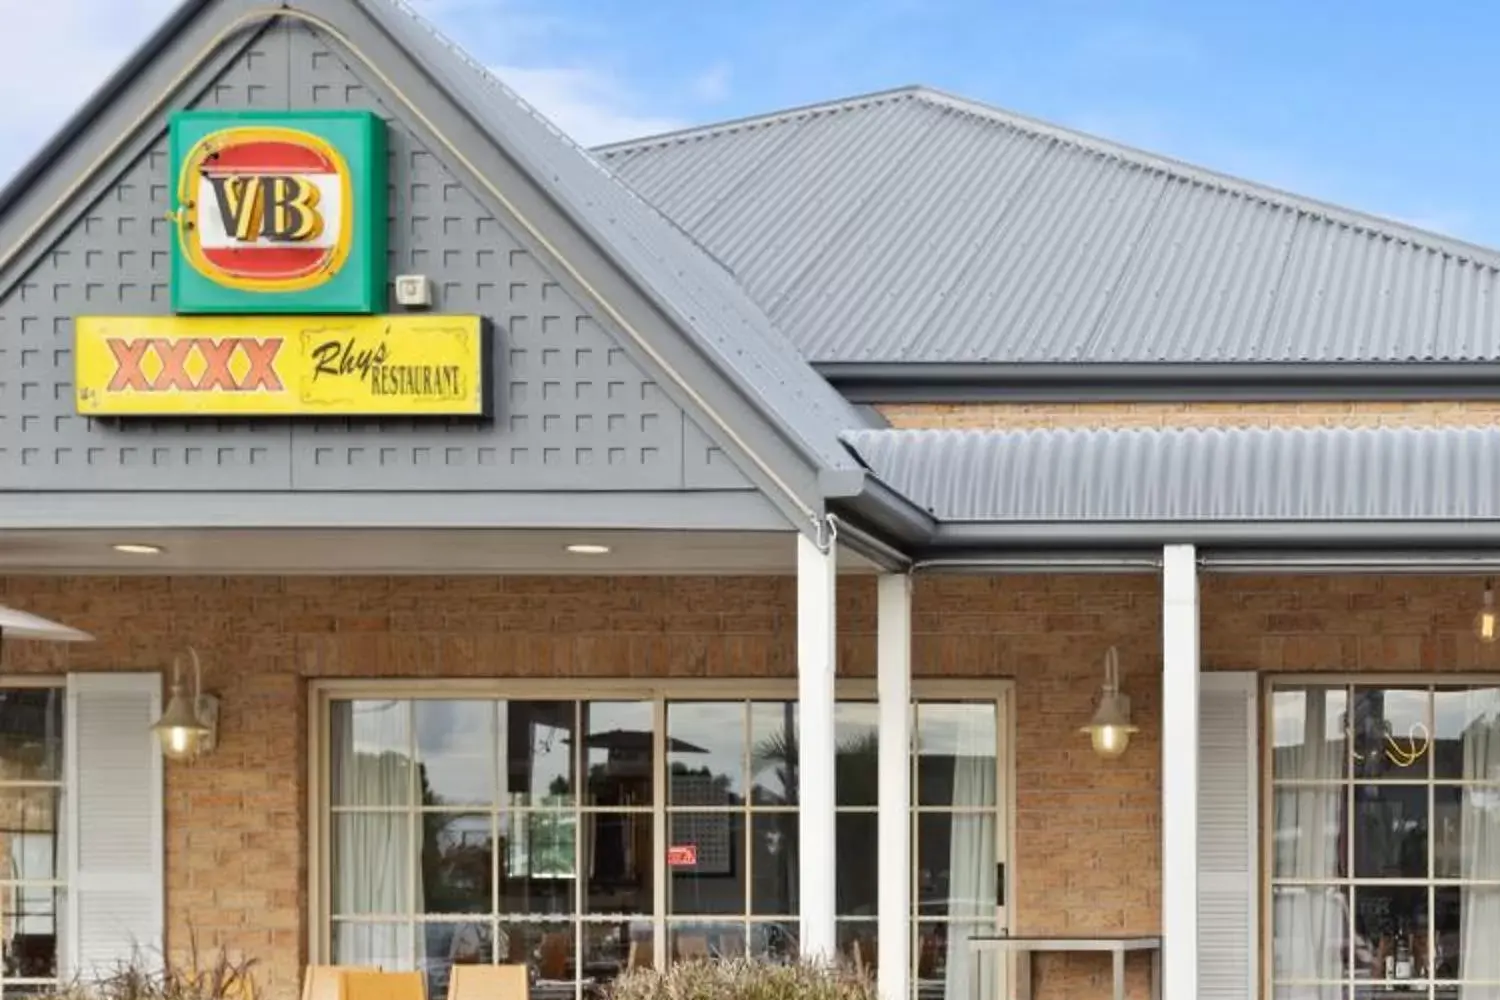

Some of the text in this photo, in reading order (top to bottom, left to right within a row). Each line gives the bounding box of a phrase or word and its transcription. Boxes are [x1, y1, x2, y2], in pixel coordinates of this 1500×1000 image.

[206, 175, 325, 241] VB
[105, 337, 285, 392] XXXX
[370, 364, 460, 396] RESTAURANT
